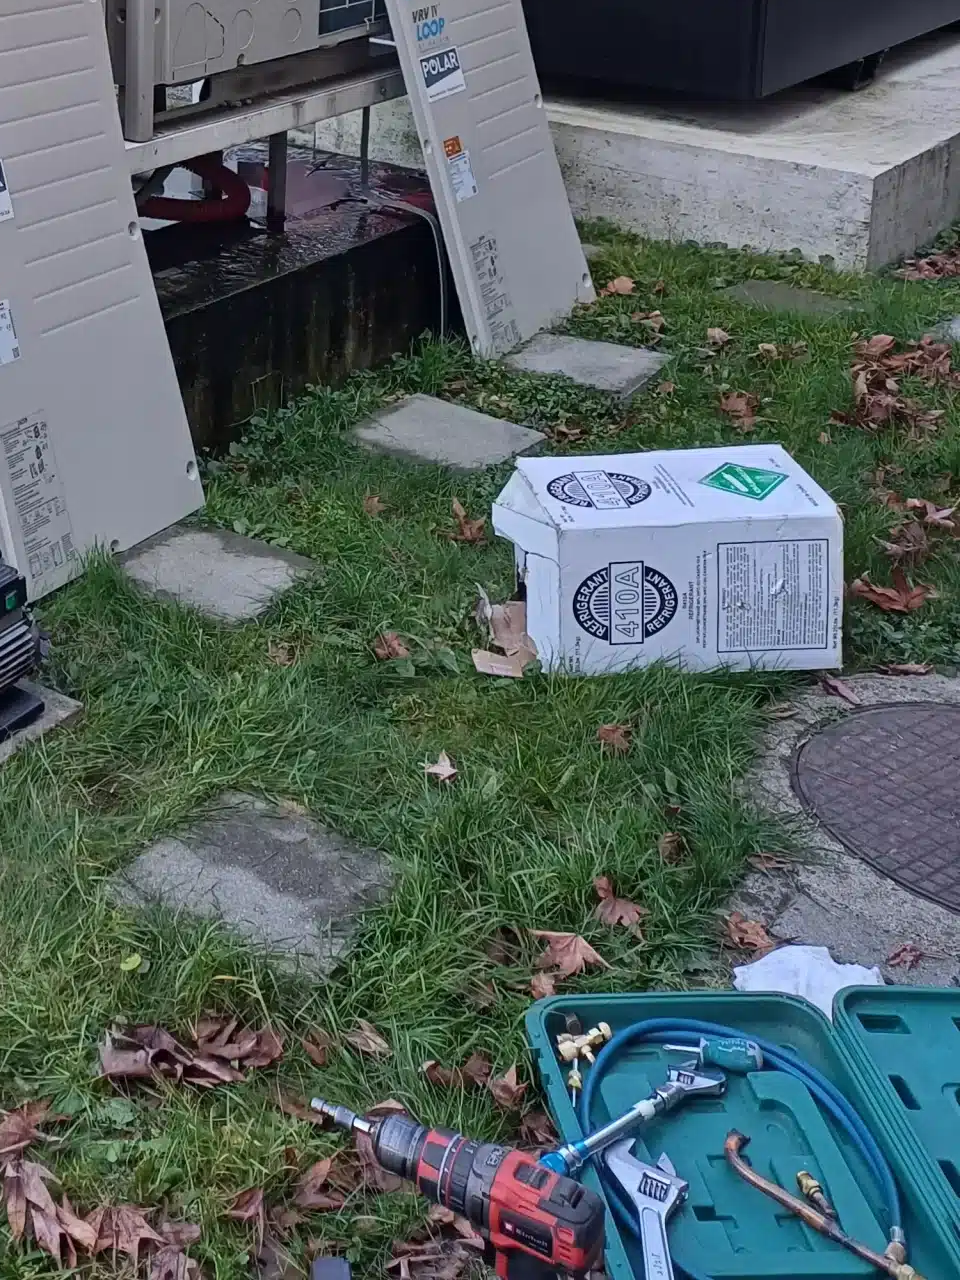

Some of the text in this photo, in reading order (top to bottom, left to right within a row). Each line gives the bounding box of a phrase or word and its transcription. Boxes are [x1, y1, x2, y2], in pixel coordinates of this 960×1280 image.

[411, 6, 430, 24] VRV
[416, 17, 445, 42] LOOP
[422, 52, 459, 78] POLAR
[581, 472, 622, 507] 410A
[576, 570, 609, 637] REFRIGERANT
[615, 566, 639, 637] 410A
[646, 571, 675, 633] REFRIGERANT
